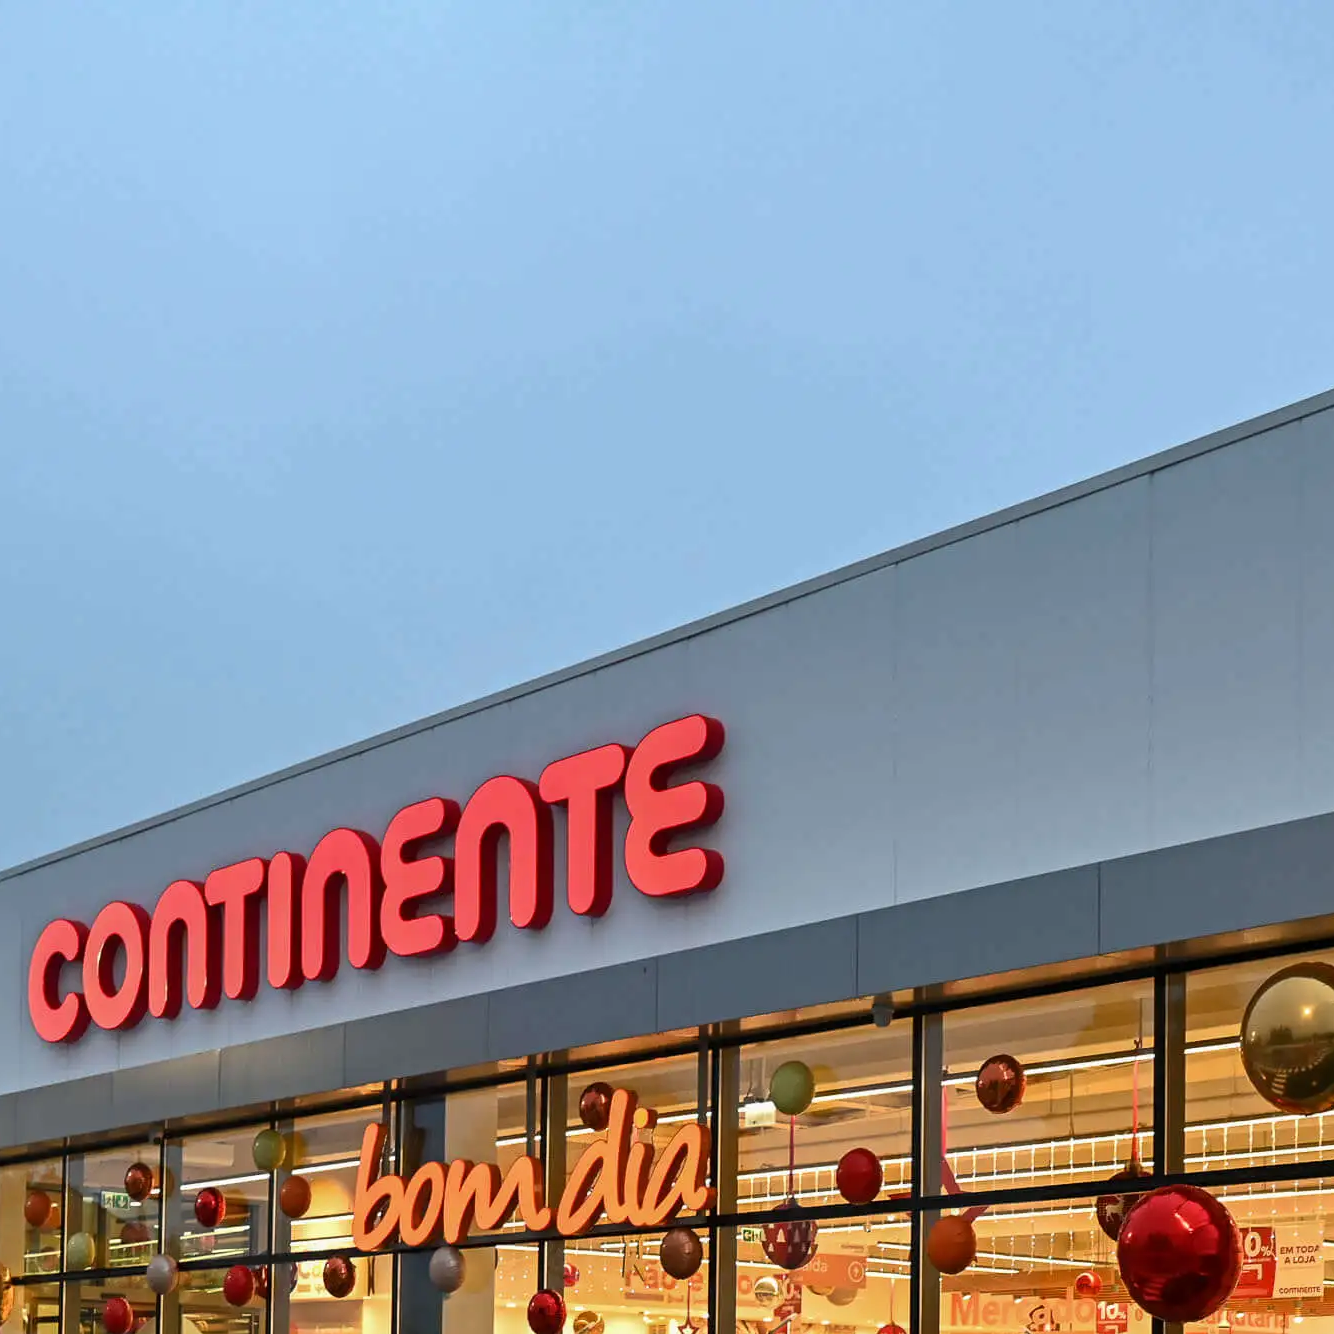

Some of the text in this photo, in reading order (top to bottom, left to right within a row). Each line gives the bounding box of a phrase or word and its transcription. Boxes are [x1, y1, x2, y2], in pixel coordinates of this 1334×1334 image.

[28, 714, 725, 1043] CONTINENTE
[352, 1088, 718, 1252] bom dia
[1279, 1246, 1294, 1255] EM
[1293, 1255, 1316, 1264] LOJA
